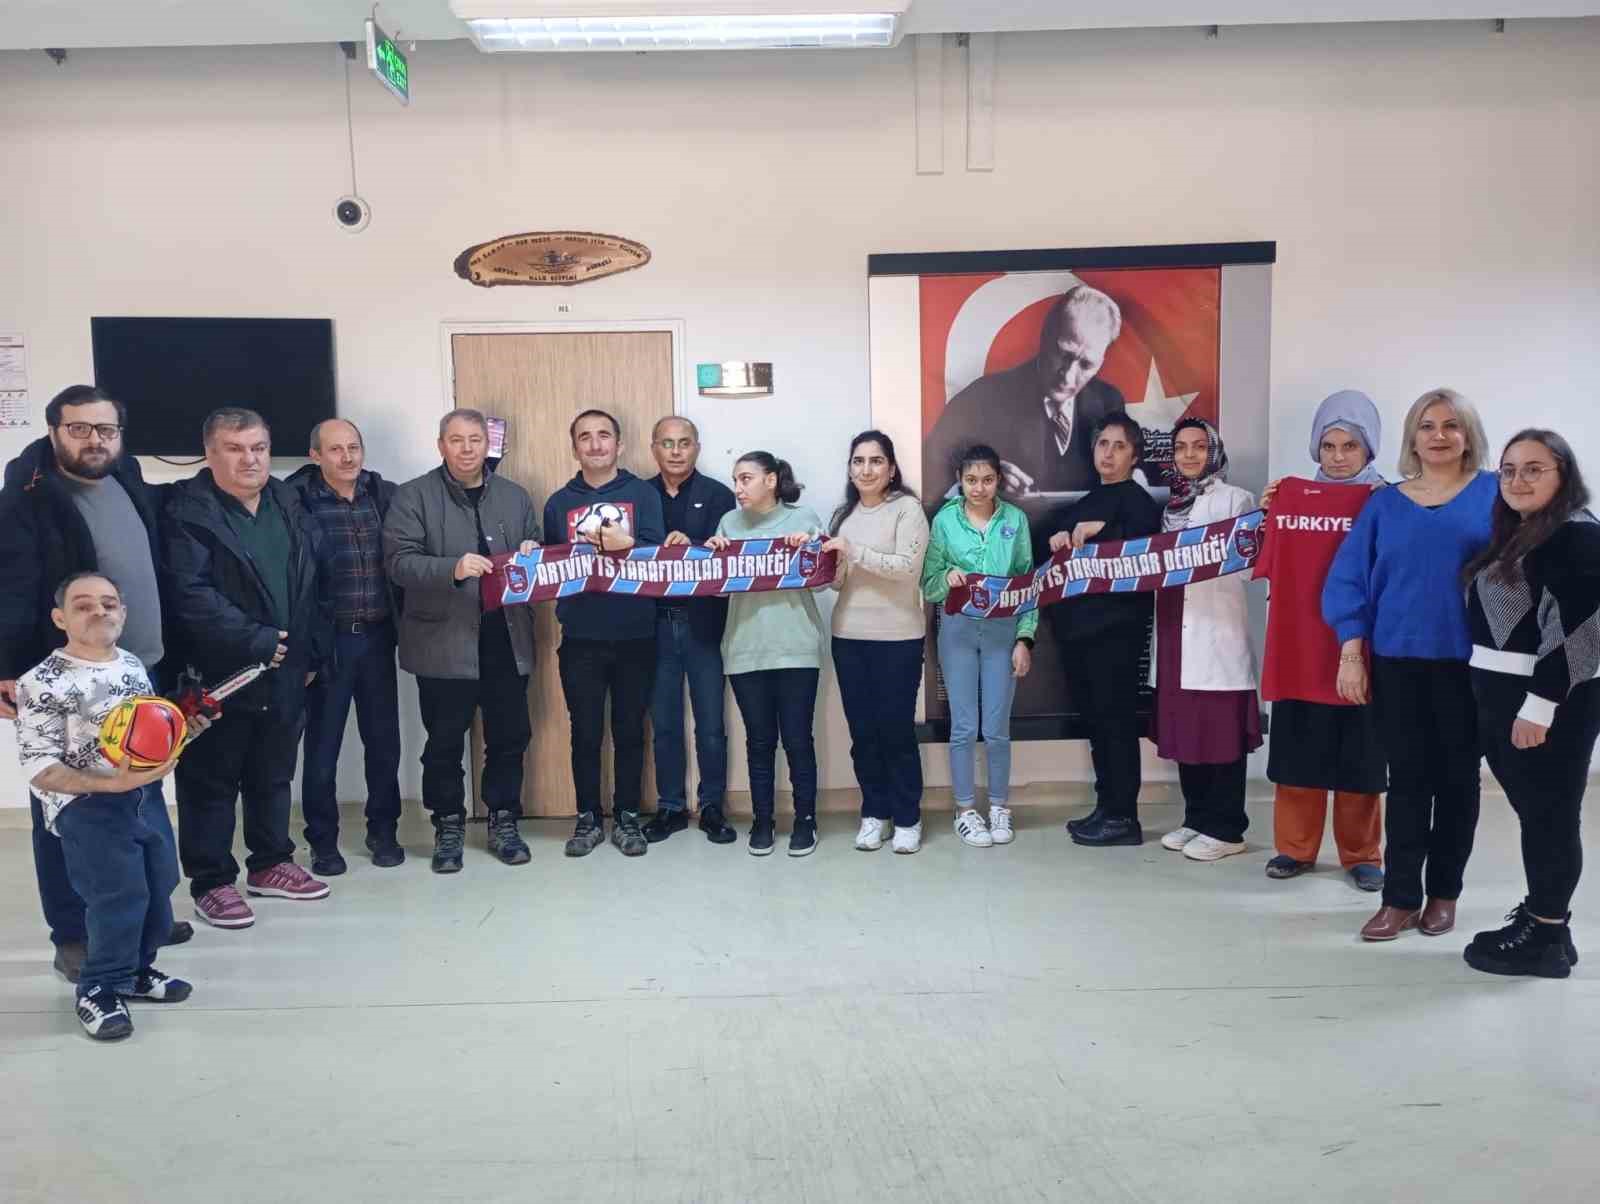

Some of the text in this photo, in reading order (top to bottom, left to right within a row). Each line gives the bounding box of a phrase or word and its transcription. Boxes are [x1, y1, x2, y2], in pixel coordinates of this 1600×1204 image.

[1276, 515, 1352, 531] TÜRKİYE
[618, 557, 722, 583] TARAFTARLAR
[727, 548, 790, 578] DERNEĞİ
[1064, 551, 1161, 582] TARAFTARLAR
[1163, 533, 1228, 572] DERNEĞİ
